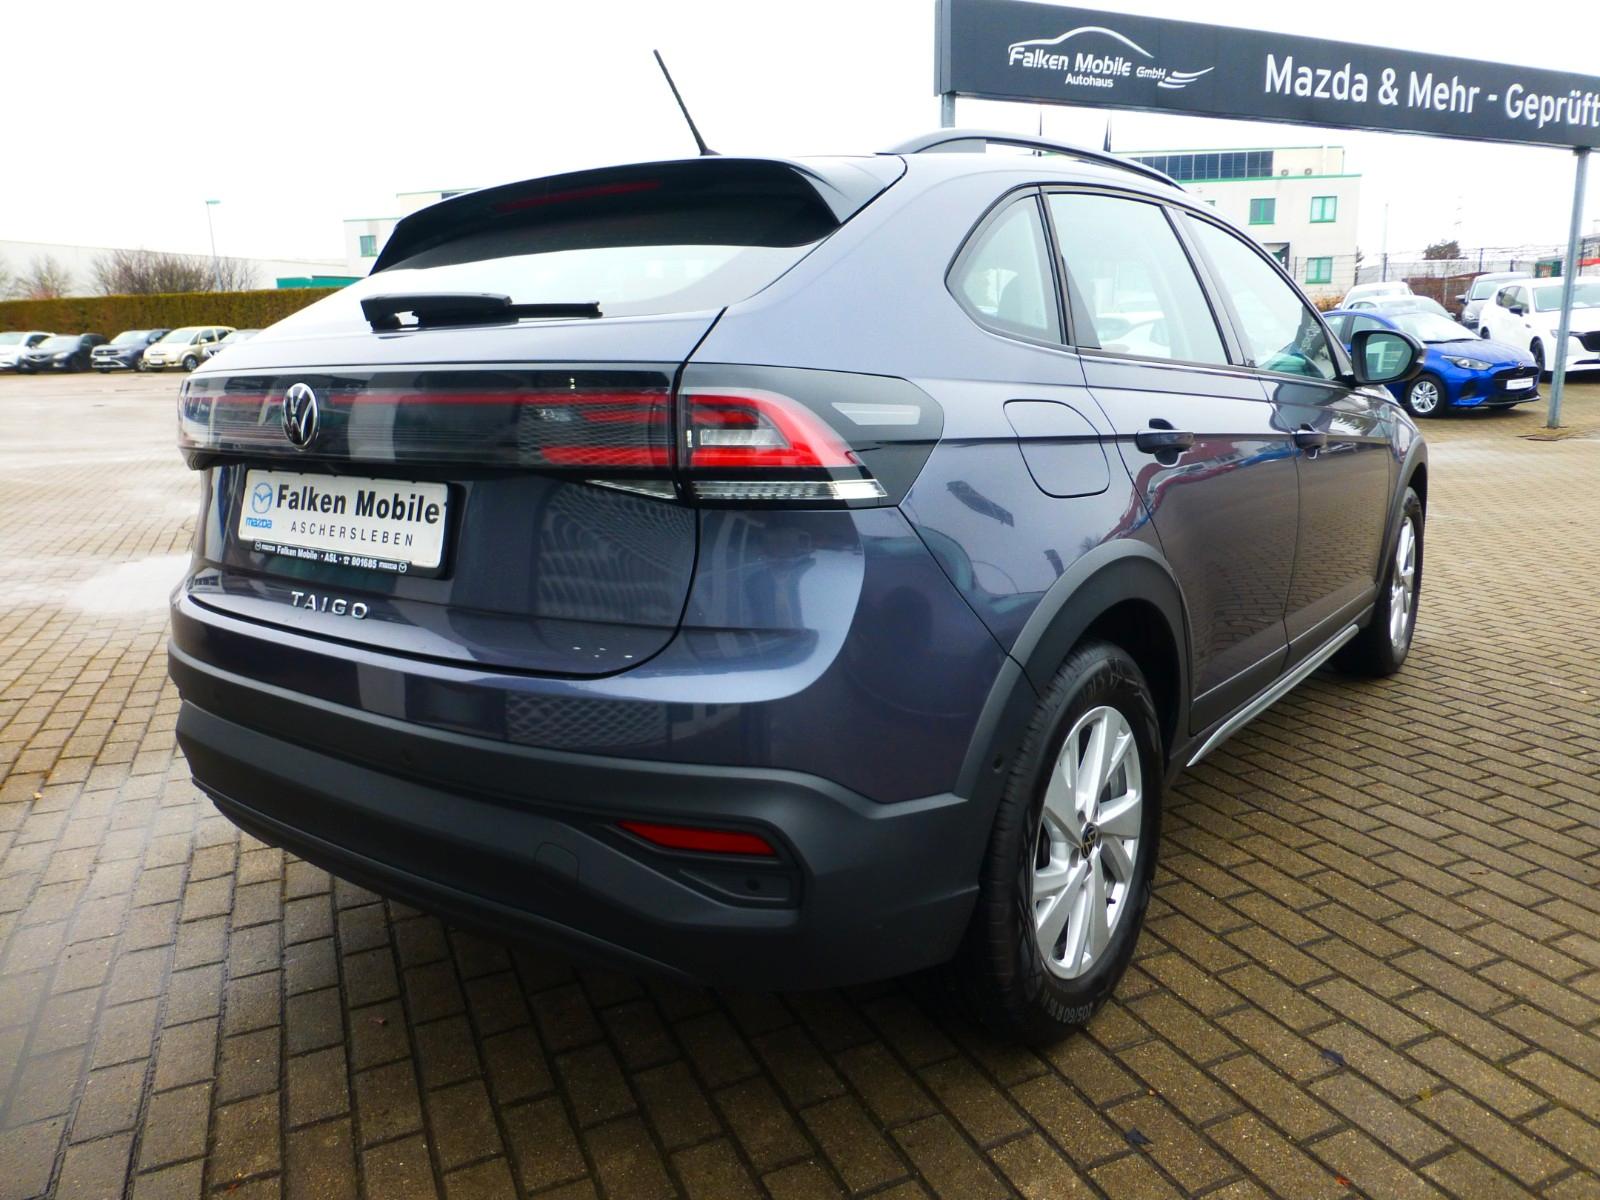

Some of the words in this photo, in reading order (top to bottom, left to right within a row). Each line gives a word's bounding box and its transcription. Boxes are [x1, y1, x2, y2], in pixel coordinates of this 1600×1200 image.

[1008, 47, 1069, 71] Falken
[1074, 53, 1132, 76] Mobile
[1136, 66, 1167, 80] GmbH
[1065, 73, 1114, 88] Autohaus
[1264, 53, 1368, 103] Mazda
[1378, 67, 1399, 106] &
[1408, 71, 1480, 114] Mehr
[1505, 83, 1600, 129] Geprüft
[276, 484, 346, 514] Falken
[355, 490, 440, 524] Mobile
[291, 521, 413, 546] ASCHERSLEBEN
[277, 545, 297, 557] Falken
[297, 549, 318, 560] Mobile
[291, 591, 369, 620] TAIGO
